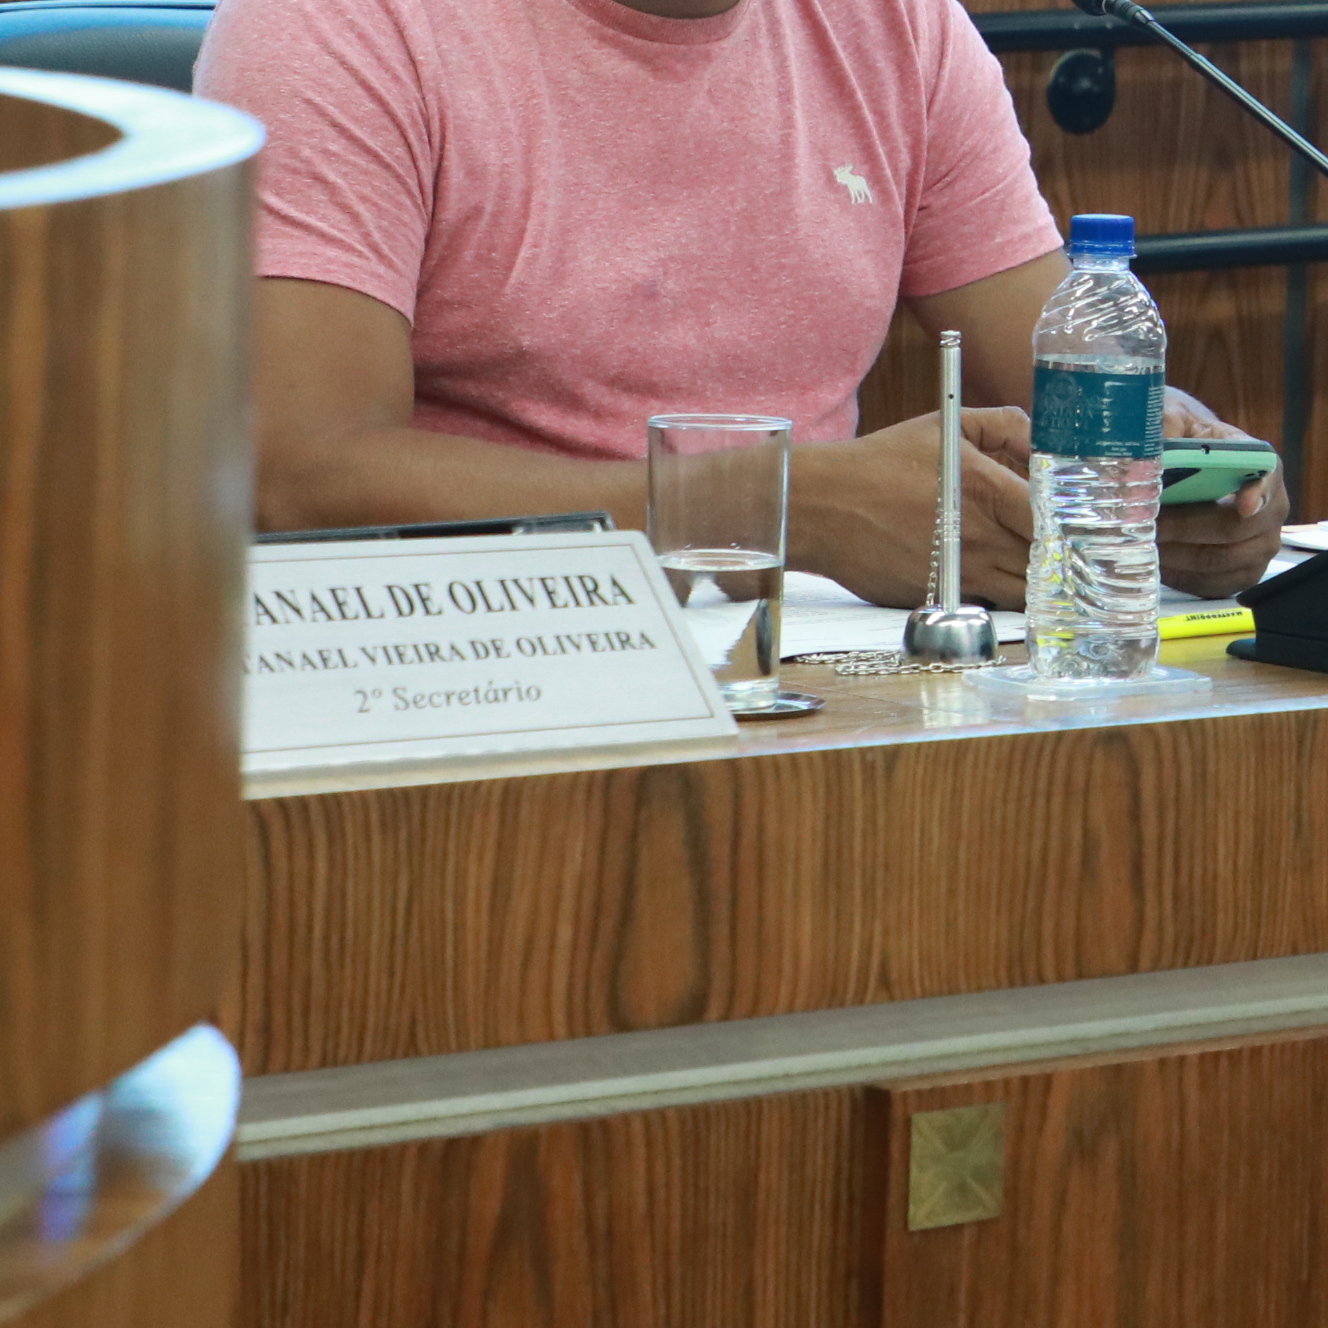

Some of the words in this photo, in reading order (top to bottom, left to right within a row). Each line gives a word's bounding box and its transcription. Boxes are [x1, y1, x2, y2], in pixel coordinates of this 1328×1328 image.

[252, 586, 385, 625] ANAEL
[385, 582, 443, 618] DE
[447, 574, 637, 615] OLIVEIRA
[360, 641, 468, 666] VIEIRA
[469, 638, 512, 660] DE
[515, 630, 658, 658] OLIVEIRA
[353, 688, 383, 714] 2º
[392, 678, 542, 711] Secretário
